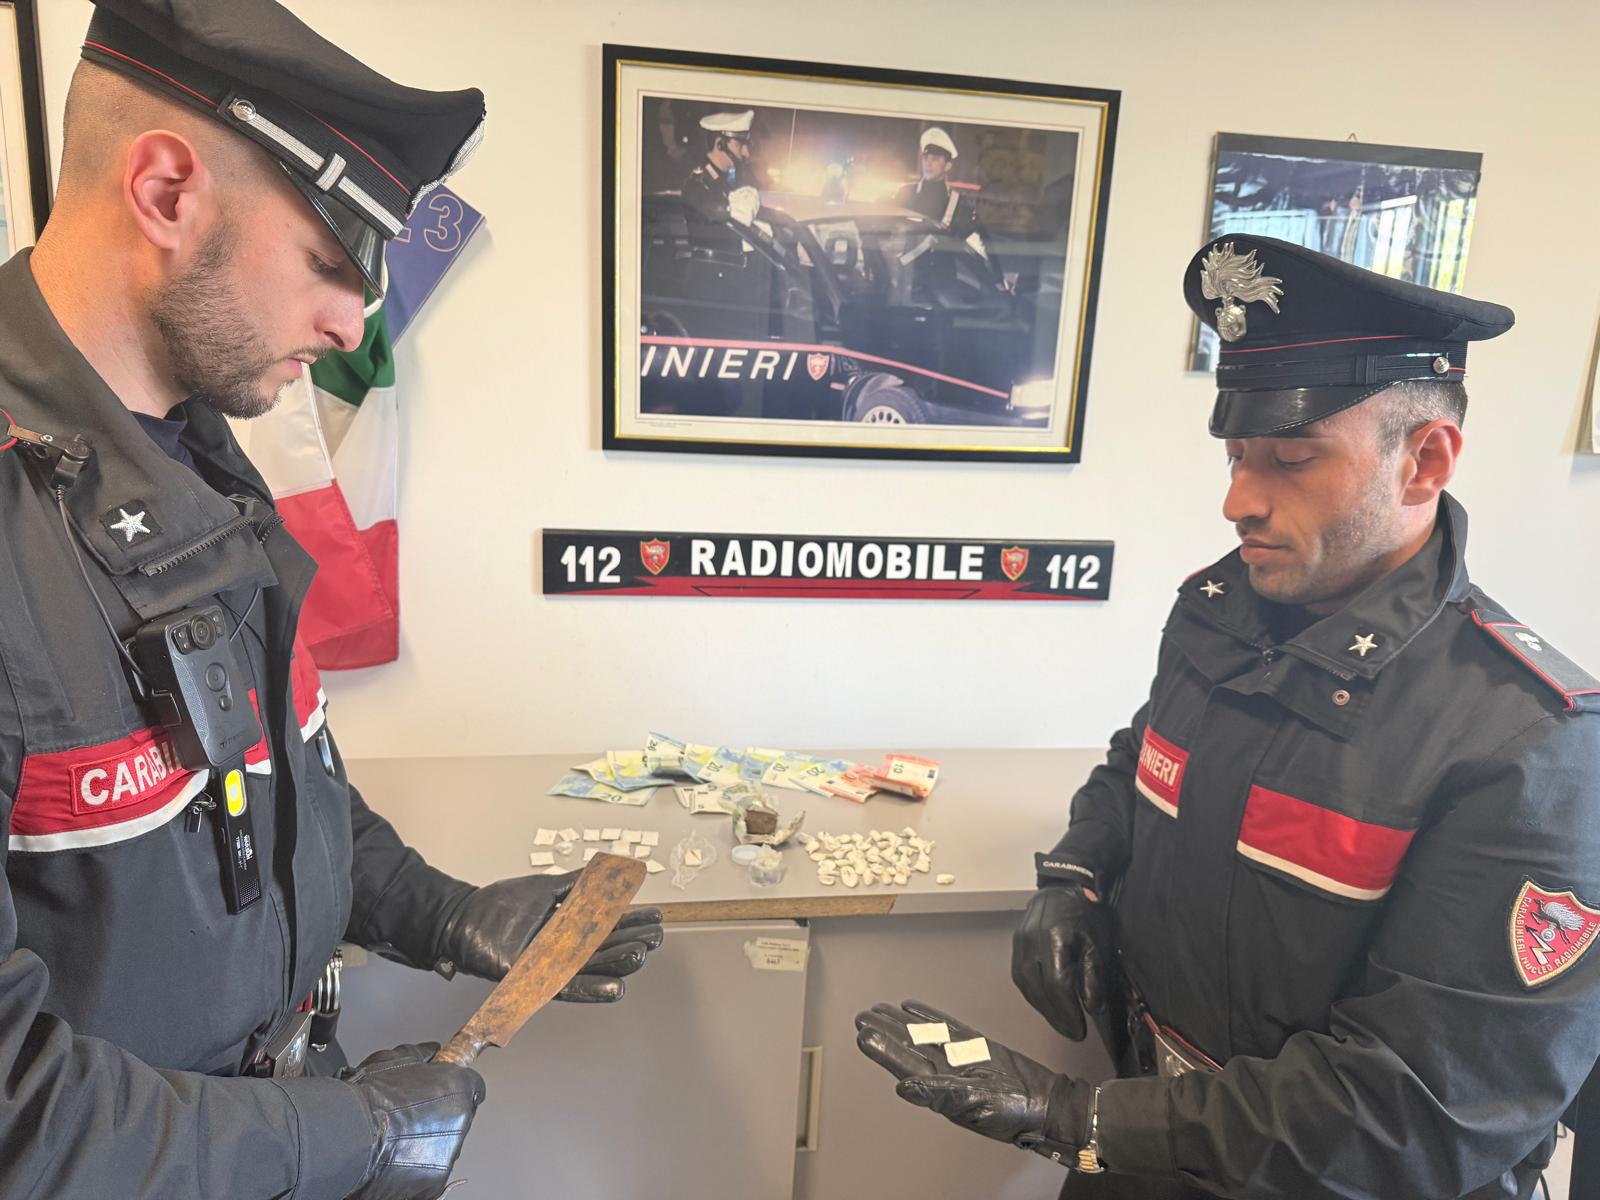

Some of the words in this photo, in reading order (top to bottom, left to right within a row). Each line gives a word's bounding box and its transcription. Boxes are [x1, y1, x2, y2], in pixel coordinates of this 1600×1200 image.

[640, 345, 799, 381] INIERI
[560, 545, 621, 584] 112
[690, 538, 985, 581] RADIOMOBILE
[1045, 553, 1100, 591] 112
[1516, 897, 1532, 953] CARABINIERI
[1554, 922, 1597, 967] RADIOMOBILE
[1521, 957, 1553, 975] NUCLEO
